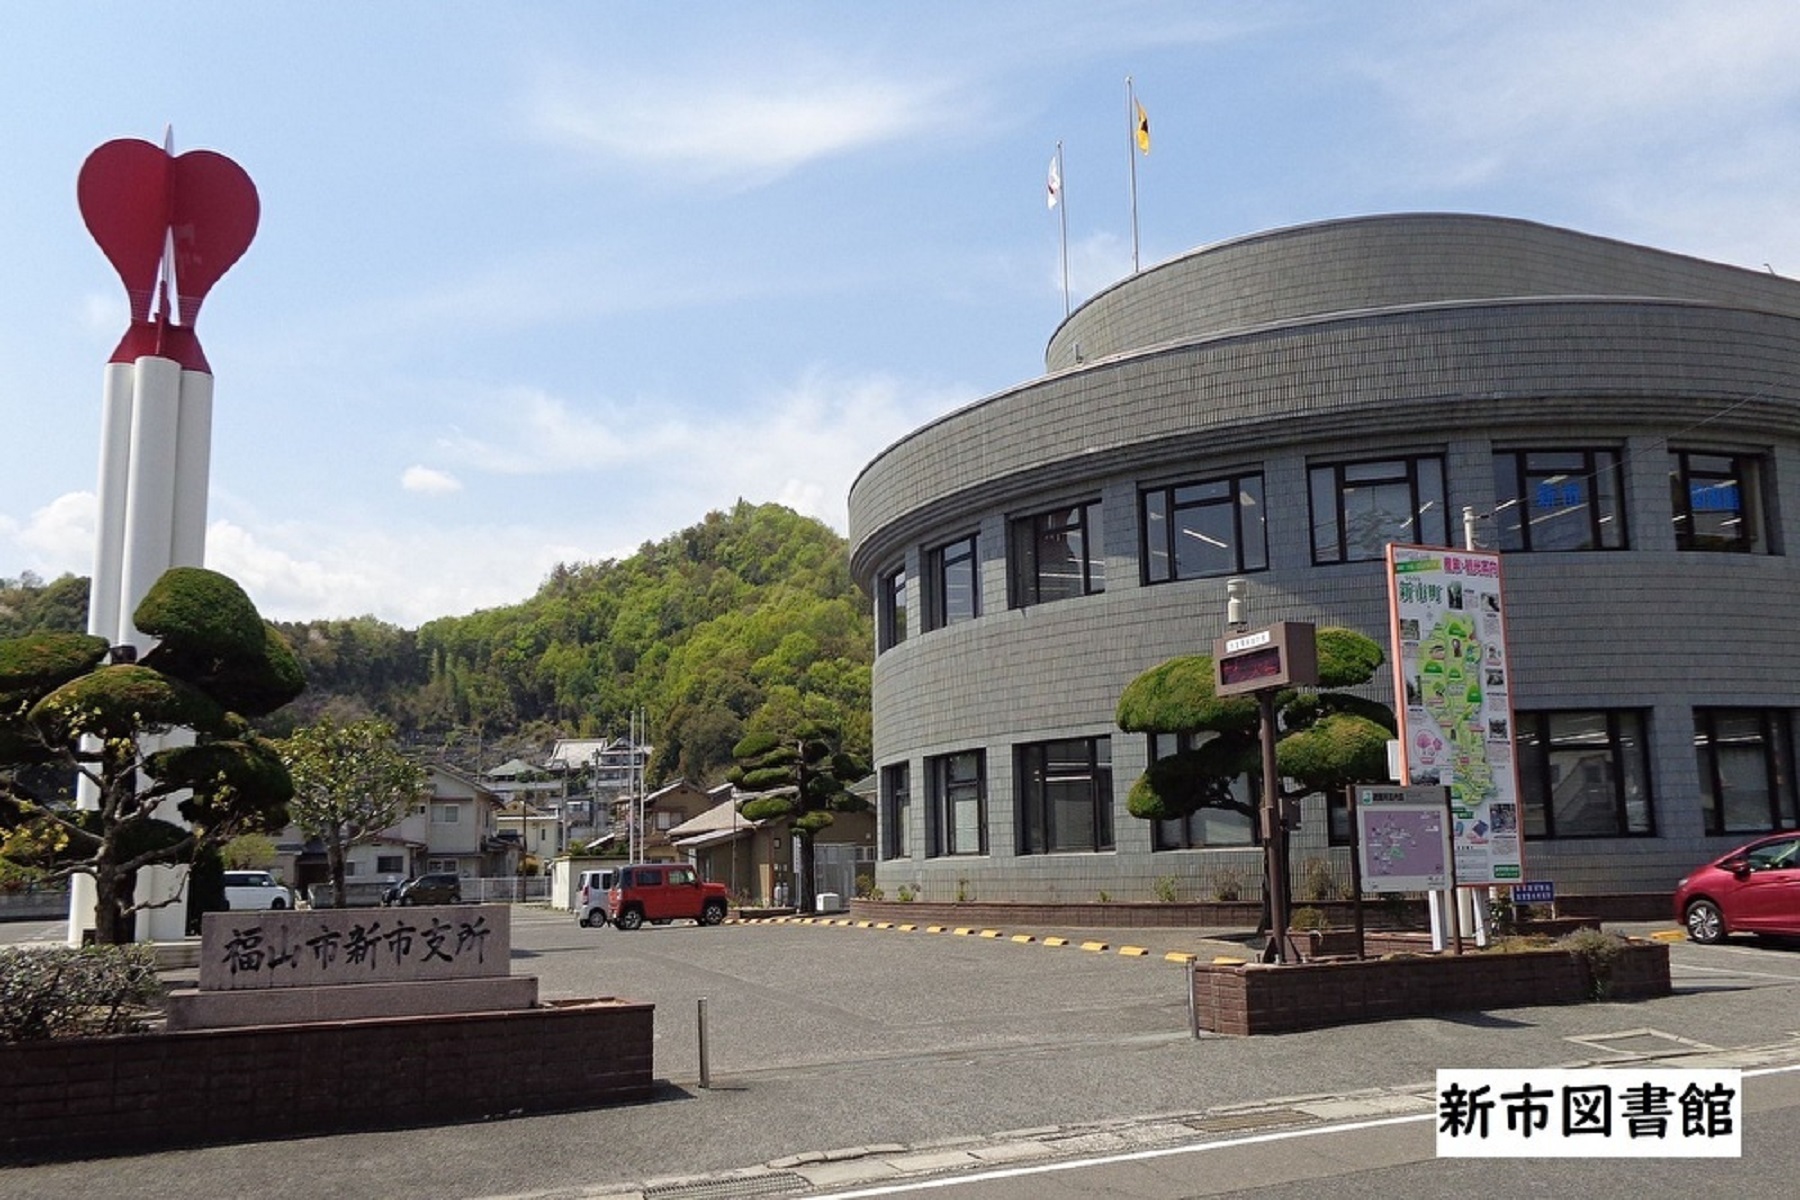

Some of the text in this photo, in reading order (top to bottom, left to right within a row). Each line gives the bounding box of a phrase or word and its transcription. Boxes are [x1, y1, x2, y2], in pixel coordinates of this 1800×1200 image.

[223, 917, 491, 974] 福山市新市支所
